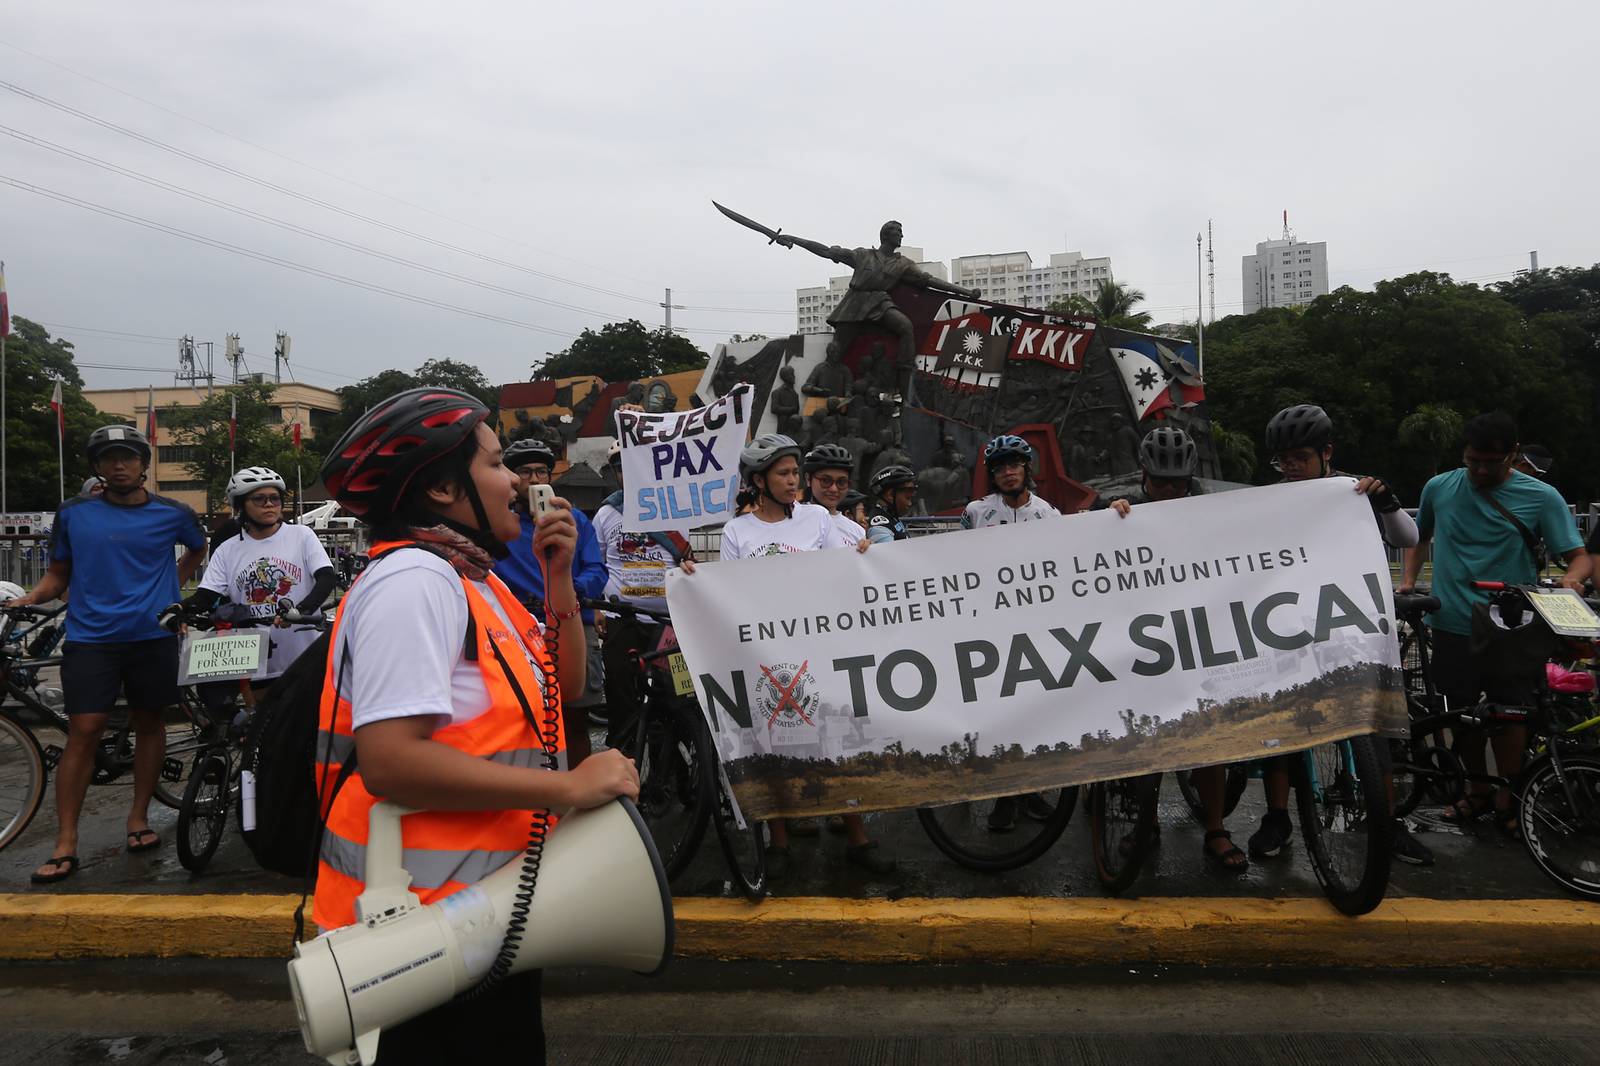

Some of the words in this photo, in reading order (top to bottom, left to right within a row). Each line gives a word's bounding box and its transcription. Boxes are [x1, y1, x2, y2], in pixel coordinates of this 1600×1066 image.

[1018, 327, 1084, 365] KKK
[619, 385, 750, 449] REJECT
[652, 436, 723, 480] PAX
[738, 597, 977, 643] ENVIRONMENT,
[994, 584, 1055, 610] AND
[1071, 546, 1309, 598] COMMUNITIES!
[863, 572, 981, 604] DEFEND
[997, 560, 1058, 585] OUR
[1073, 546, 1166, 574] LAND,
[194, 639, 257, 653] PHILIPPINES
[197, 658, 218, 669] FOR
[221, 655, 250, 667] SALE!
[212, 649, 233, 659] NOT
[832, 649, 938, 719] TO
[954, 622, 1118, 703] PAX
[1128, 572, 1390, 677] SILICA!
